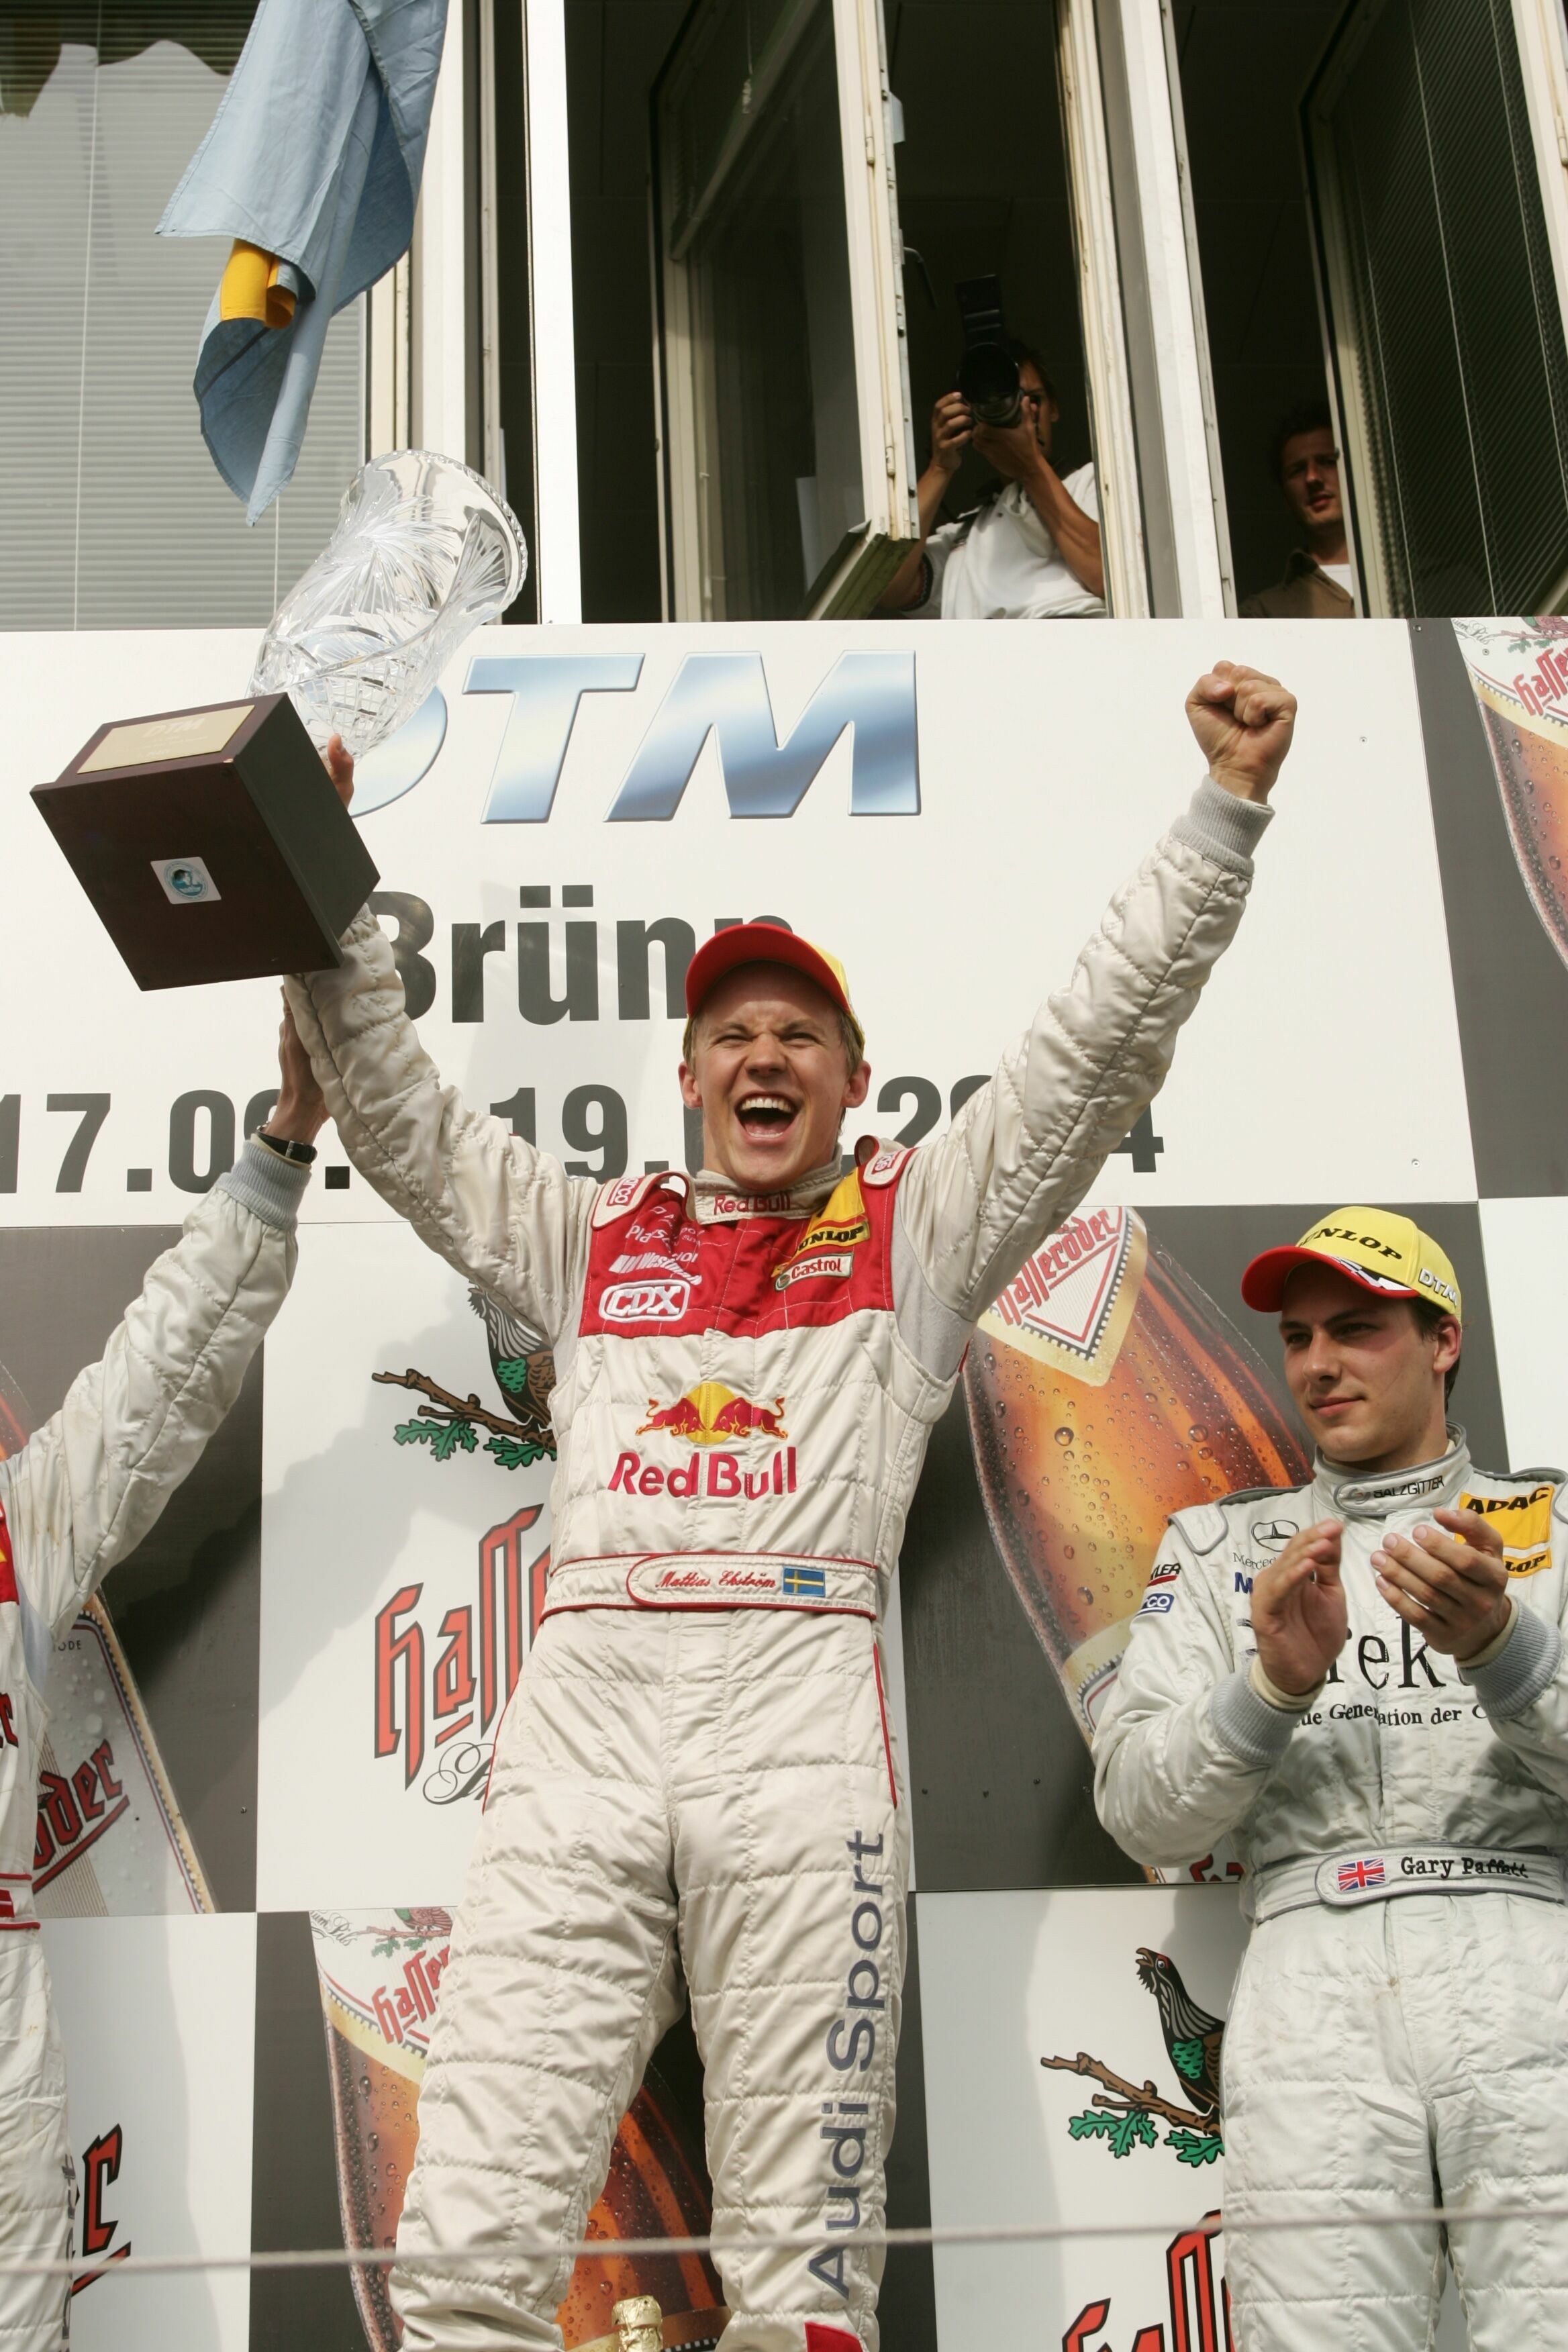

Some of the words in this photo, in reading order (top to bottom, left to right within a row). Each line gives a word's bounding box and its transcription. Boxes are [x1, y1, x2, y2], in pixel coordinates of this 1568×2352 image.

[371, 884, 793, 1025] Brün
[714, 1193, 750, 1215] Red
[752, 1191, 791, 1212] Bull
[791, 1257, 842, 1279] Castrol
[607, 1451, 700, 1498] Red
[706, 1446, 798, 1500] Bull
[1373, 1475, 1445, 1499] SALZGITTER
[1465, 1487, 1551, 1516] ADAC
[655, 1571, 710, 1589] Mattias
[1328, 1703, 1422, 1726] Generation
[1430, 1707, 1462, 1725] der
[1400, 1855, 1455, 1879] Gary
[1461, 1857, 1529, 1879] Paffett
[826, 1829, 885, 2073] Sport
[807, 2101, 869, 2300] Audi
